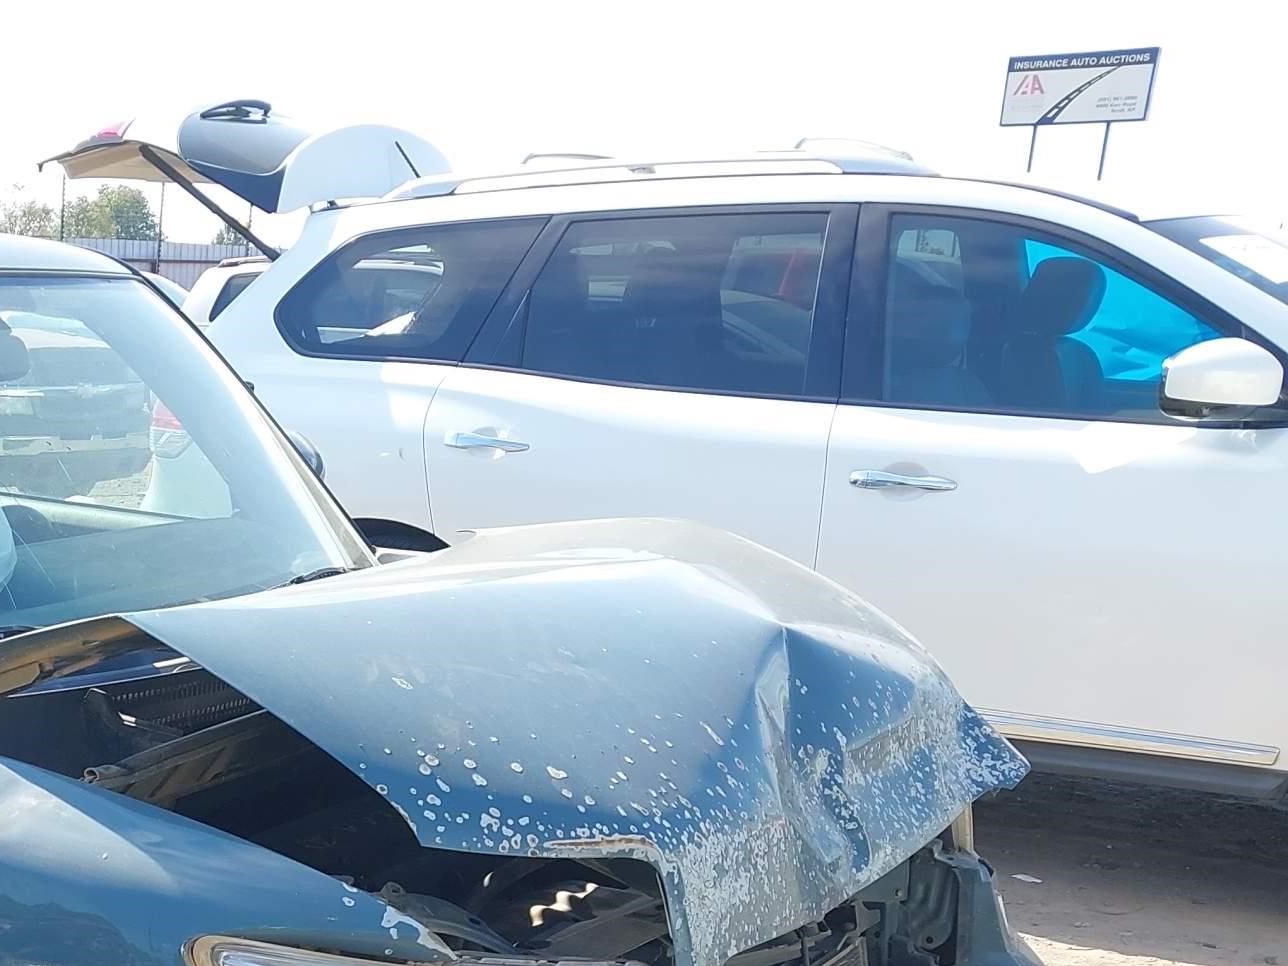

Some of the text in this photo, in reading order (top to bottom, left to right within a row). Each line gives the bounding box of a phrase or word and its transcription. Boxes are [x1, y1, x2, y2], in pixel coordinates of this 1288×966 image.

[1014, 52, 1150, 70] INSURANCE AUTO AUCTIONS
